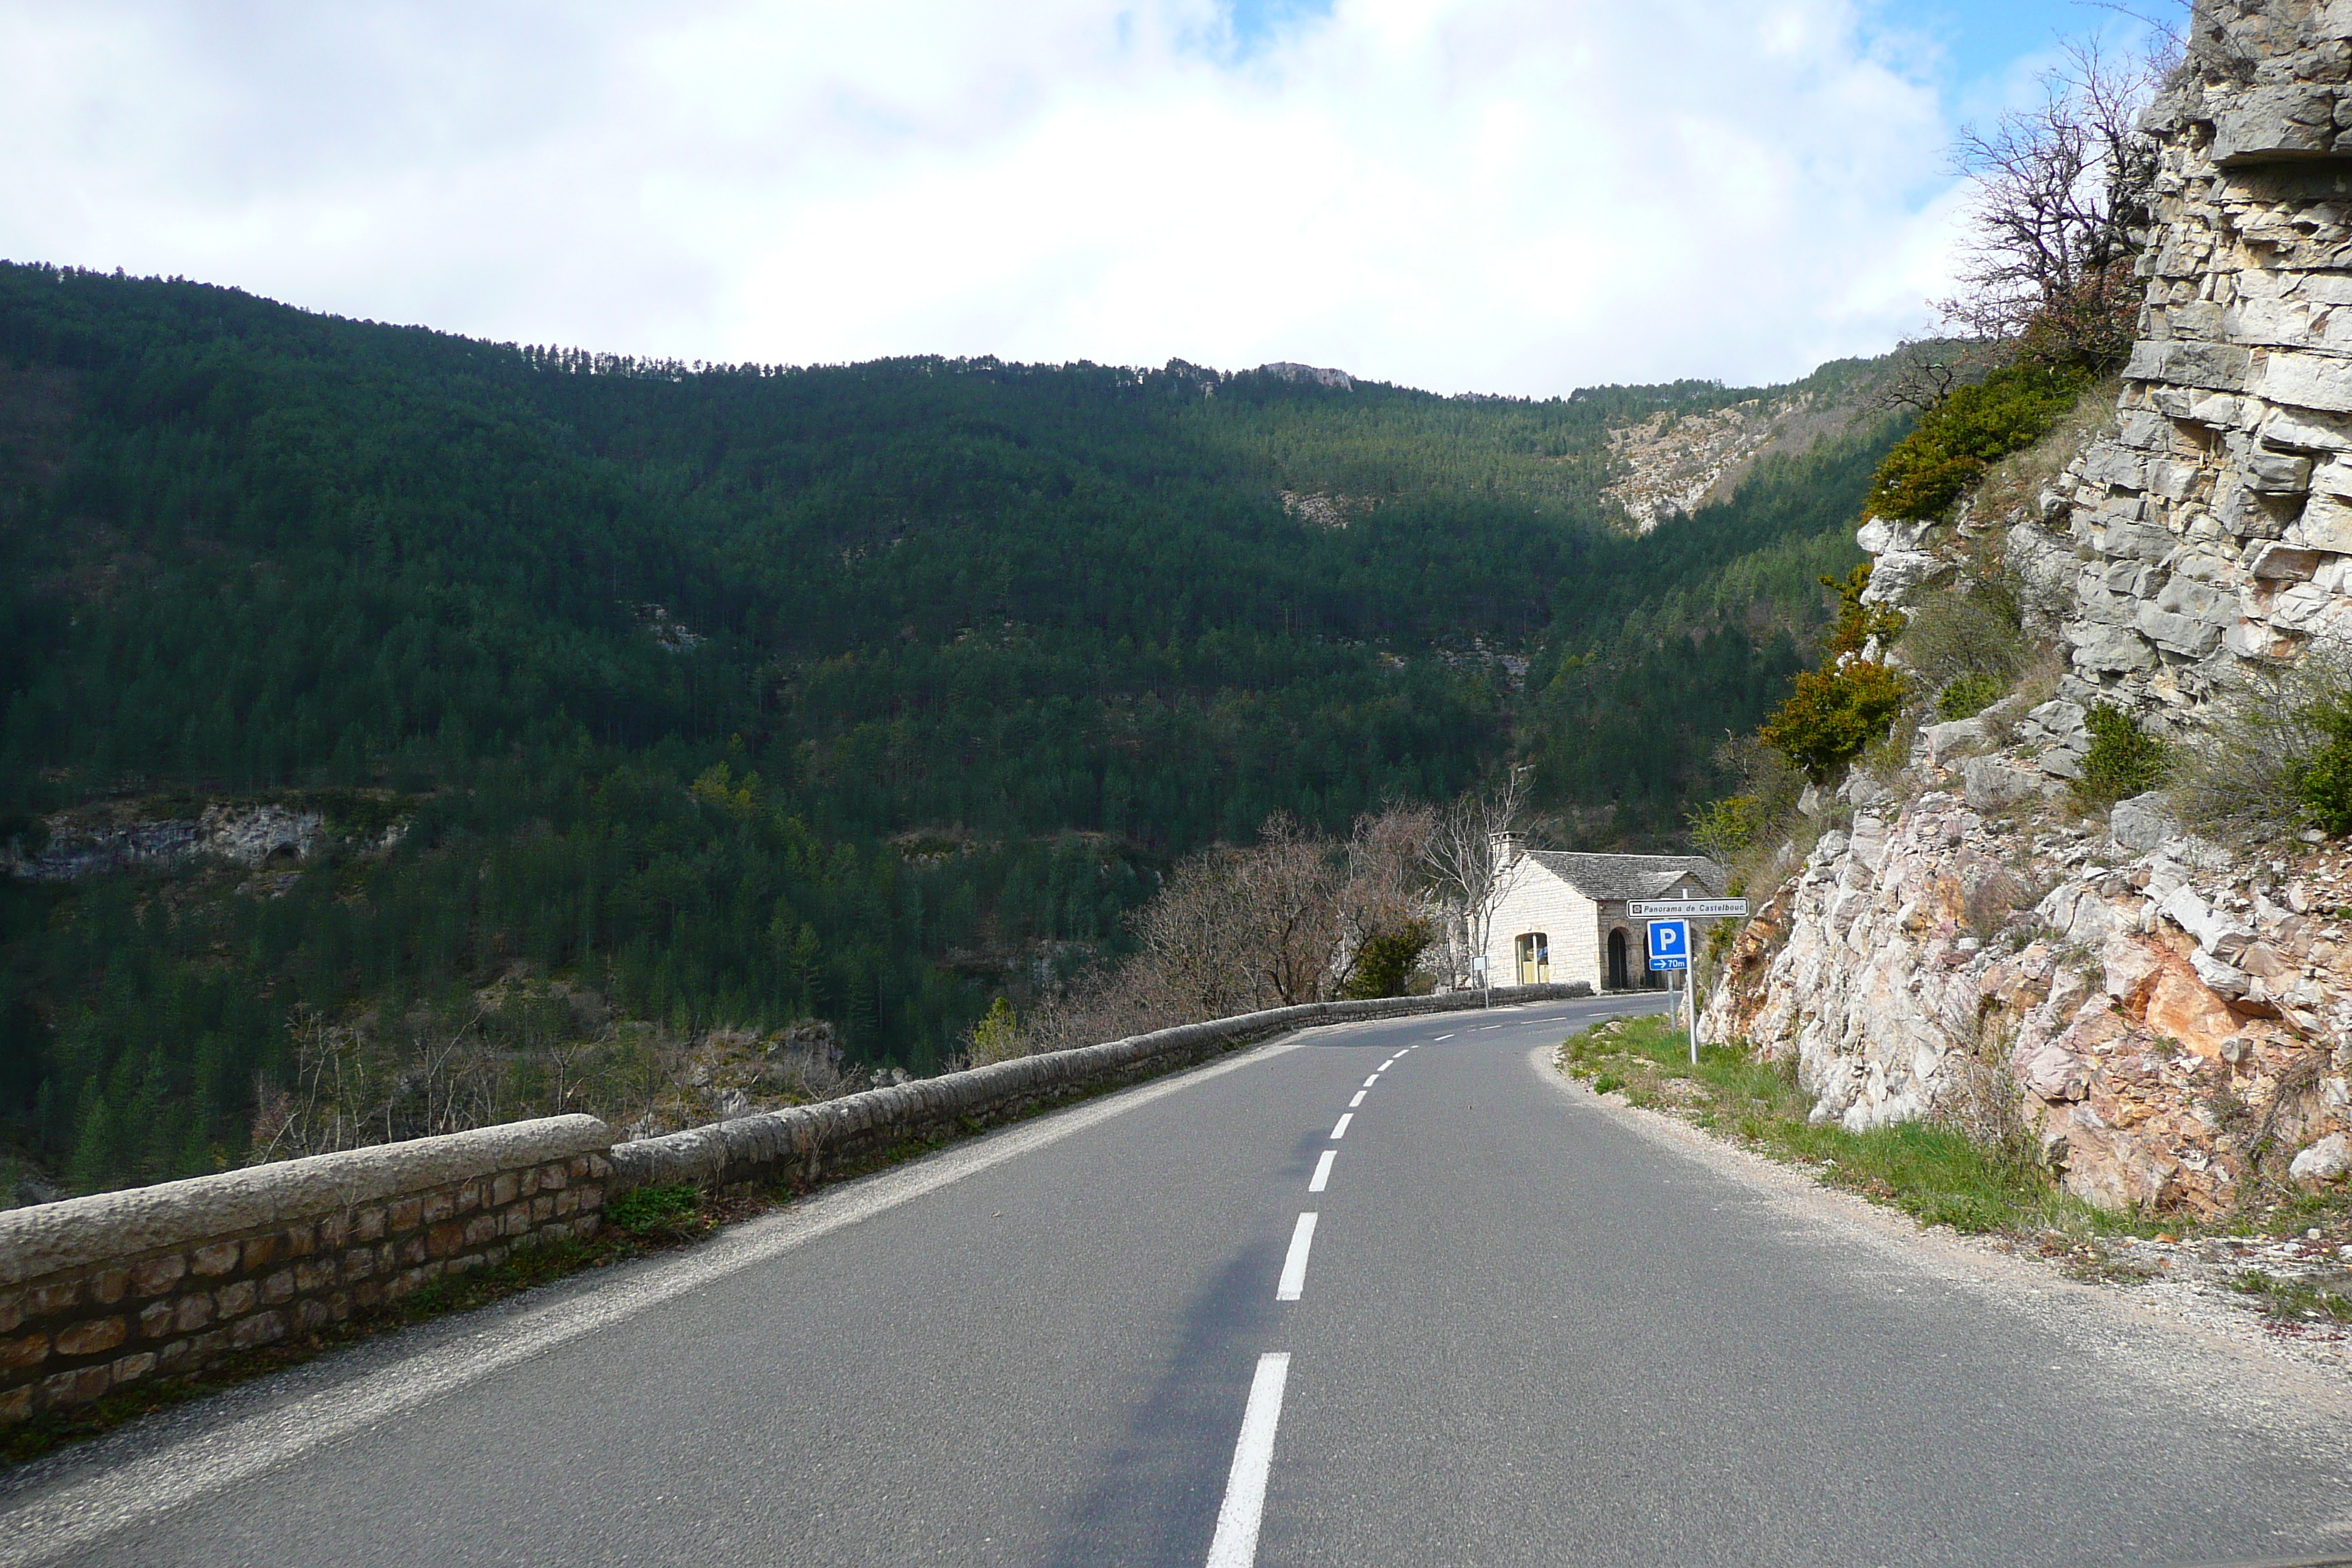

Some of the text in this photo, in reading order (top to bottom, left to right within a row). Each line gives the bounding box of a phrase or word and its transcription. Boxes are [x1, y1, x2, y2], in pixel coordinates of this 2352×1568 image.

[1644, 905, 1682, 913] Panorama
[1699, 903, 1744, 912] Castelbouc
[1659, 928, 1676, 951] P
[1668, 960, 1685, 968] 70m
